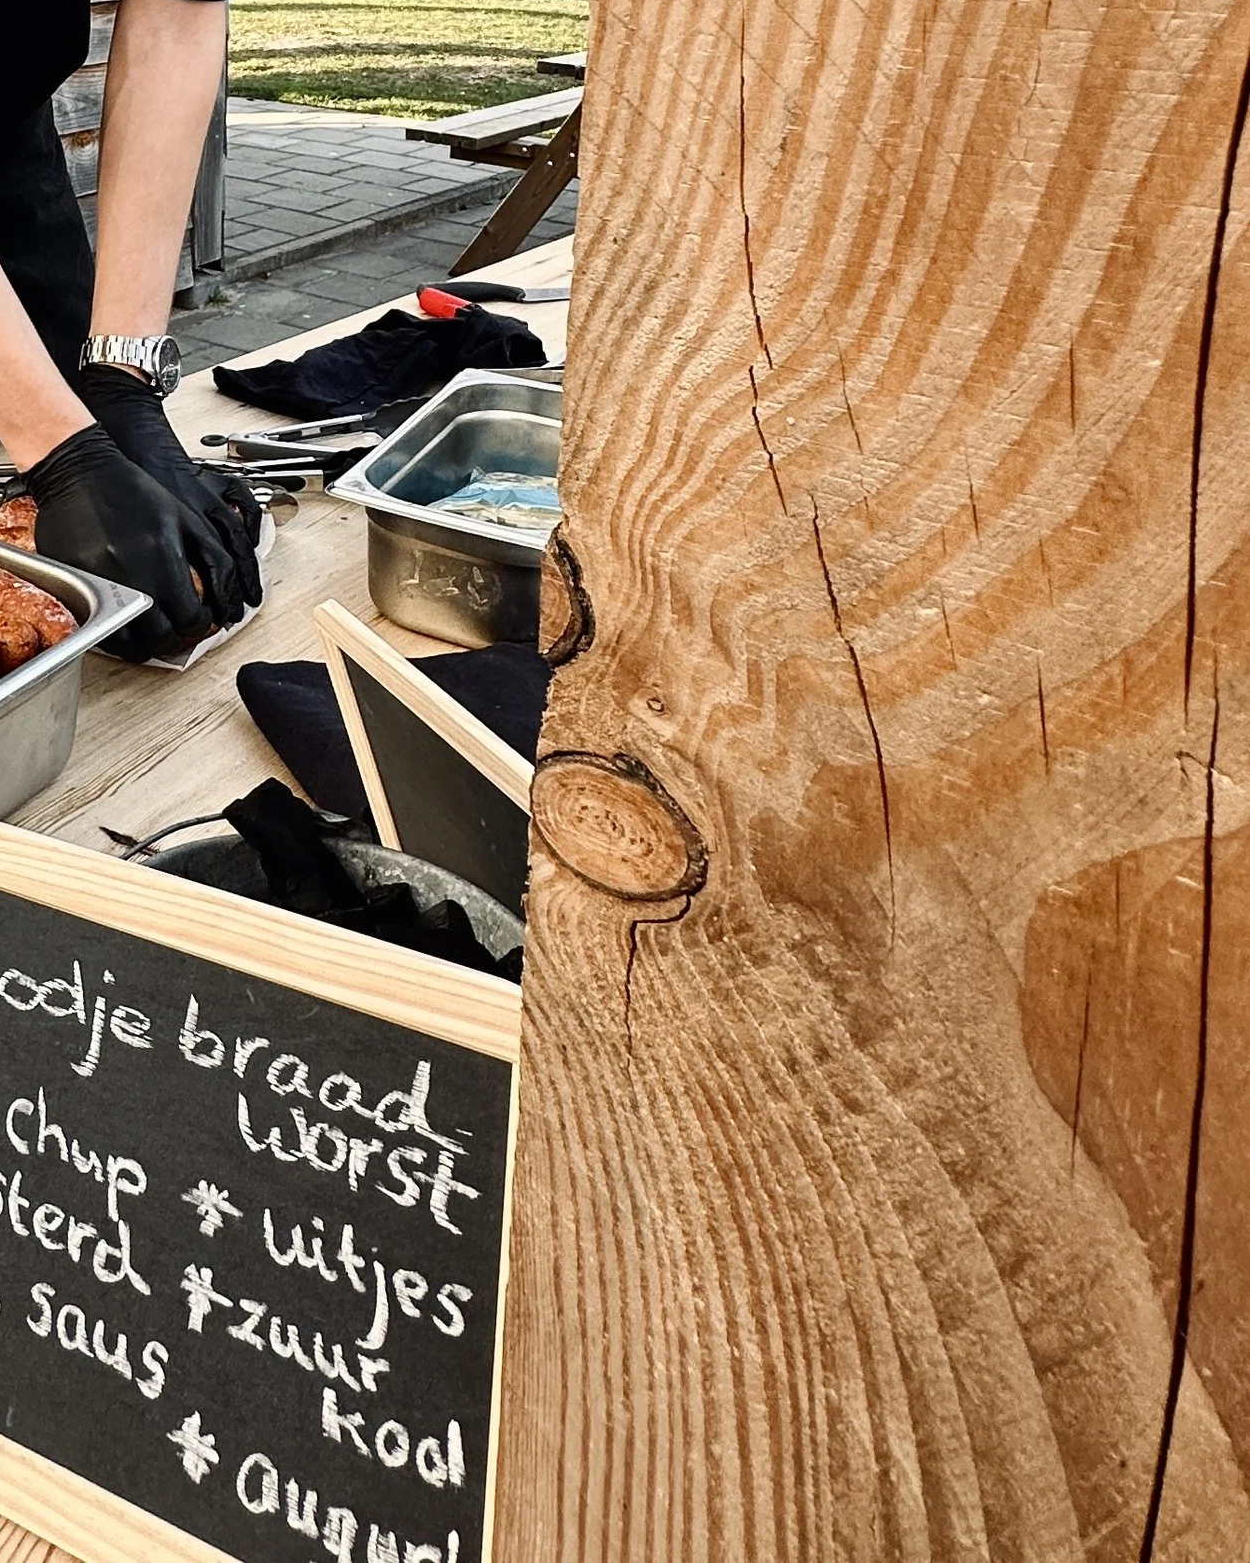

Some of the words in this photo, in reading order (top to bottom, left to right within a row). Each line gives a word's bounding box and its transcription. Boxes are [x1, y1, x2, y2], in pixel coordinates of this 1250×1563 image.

[263, 1208, 474, 1350] uitjes
[26, 1282, 169, 1400] saus
[226, 1298, 391, 1393] zuur
